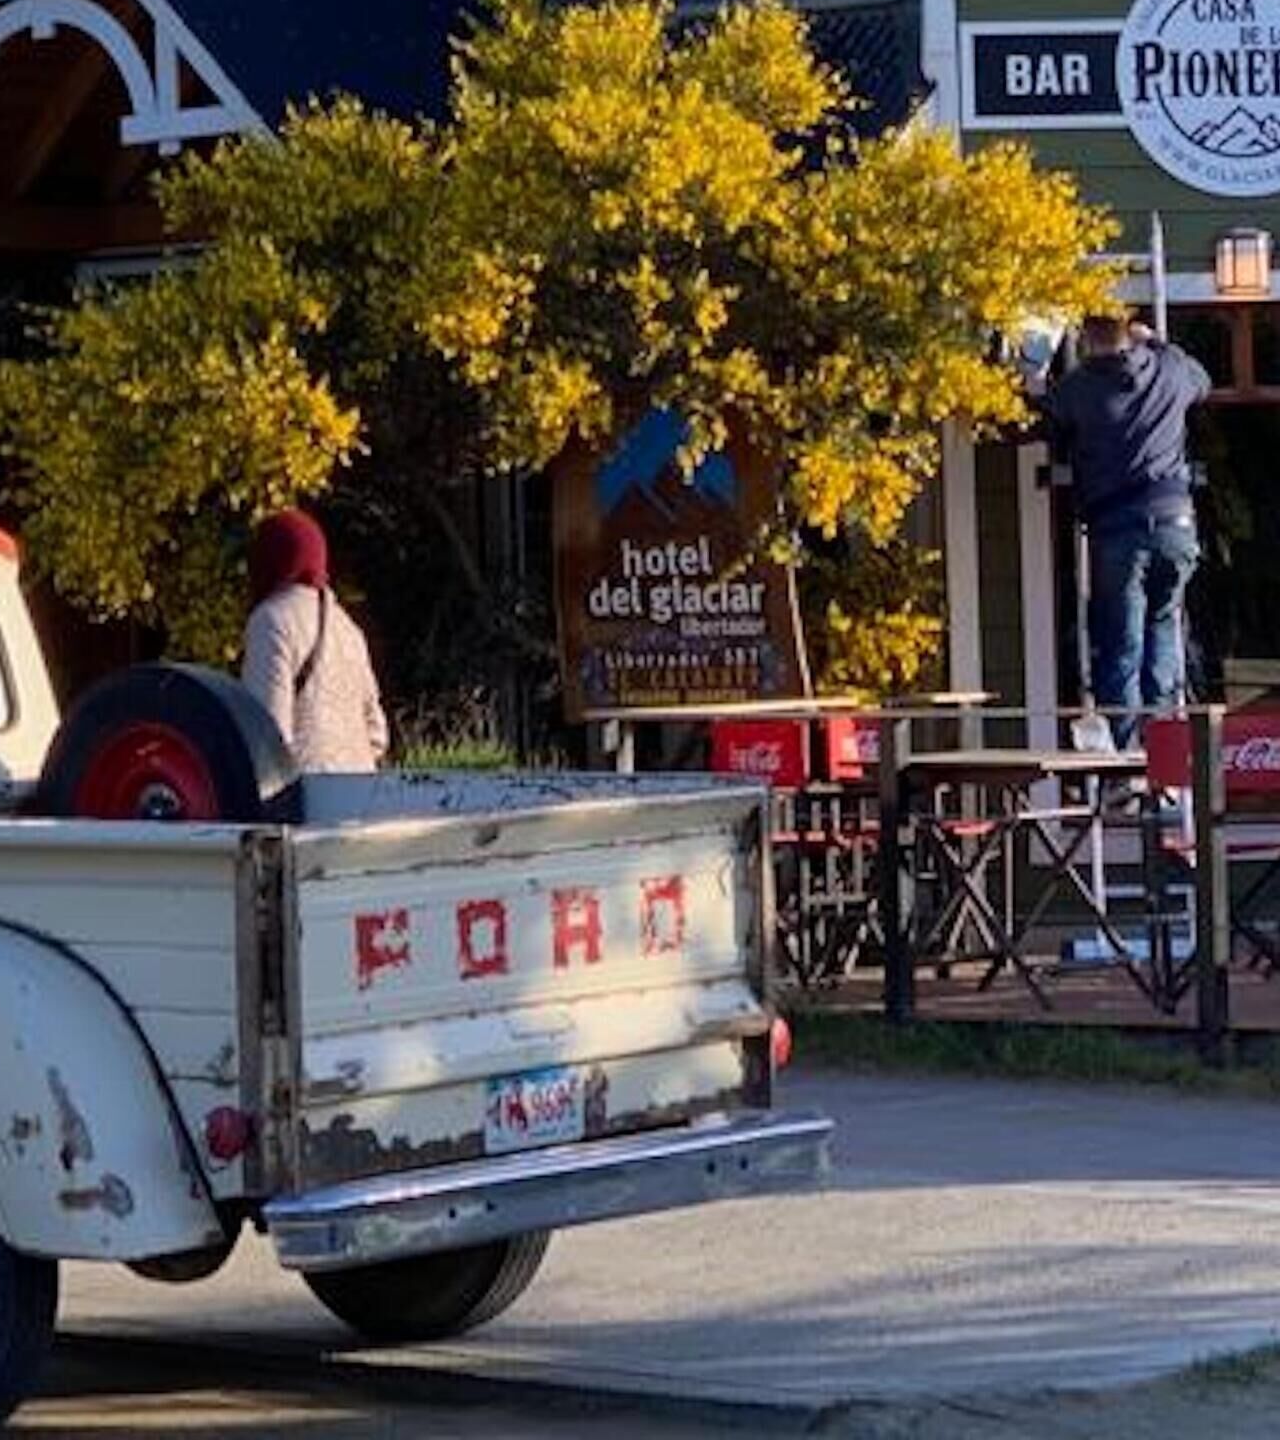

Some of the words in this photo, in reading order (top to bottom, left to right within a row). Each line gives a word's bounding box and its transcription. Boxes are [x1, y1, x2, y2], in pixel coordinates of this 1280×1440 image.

[1239, 26, 1261, 46] DE
[1005, 54, 1091, 96] BAR
[622, 536, 711, 578] hotel
[589, 580, 642, 617] del
[650, 580, 765, 623] glaciar
